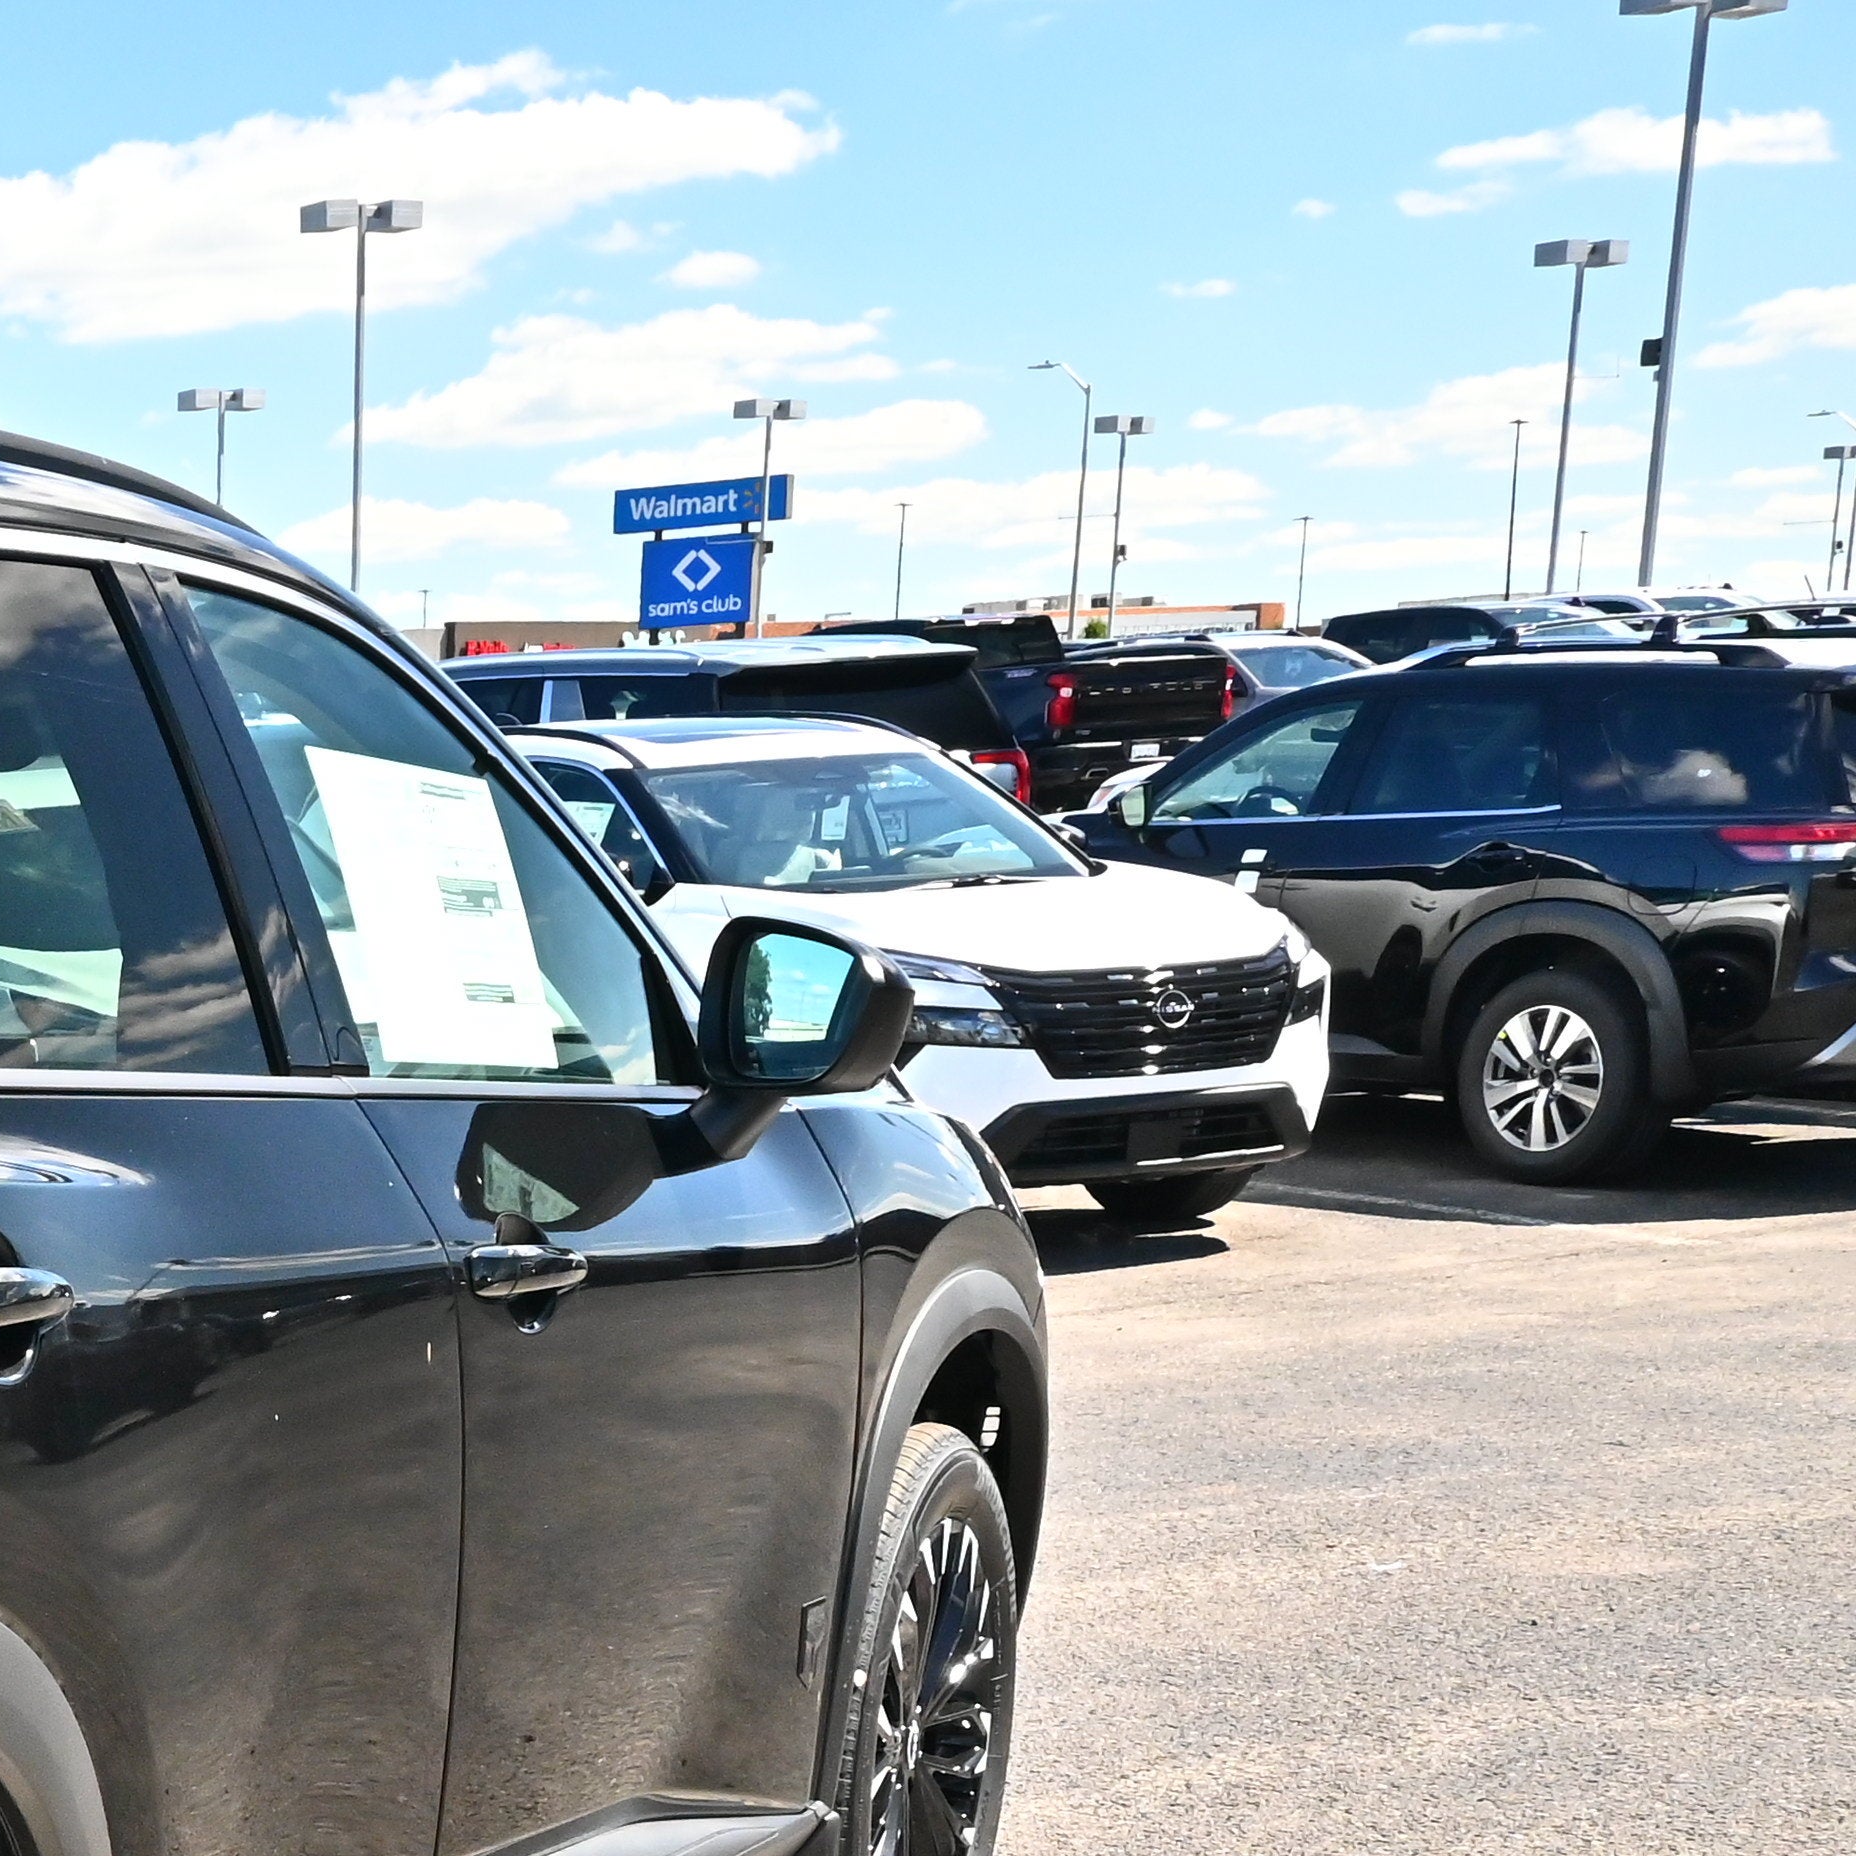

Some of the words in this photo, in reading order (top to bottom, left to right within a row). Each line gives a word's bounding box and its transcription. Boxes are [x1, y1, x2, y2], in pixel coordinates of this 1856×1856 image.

[629, 488, 738, 521] Walmart
[648, 599, 698, 617] sam's
[701, 594, 742, 613] club
